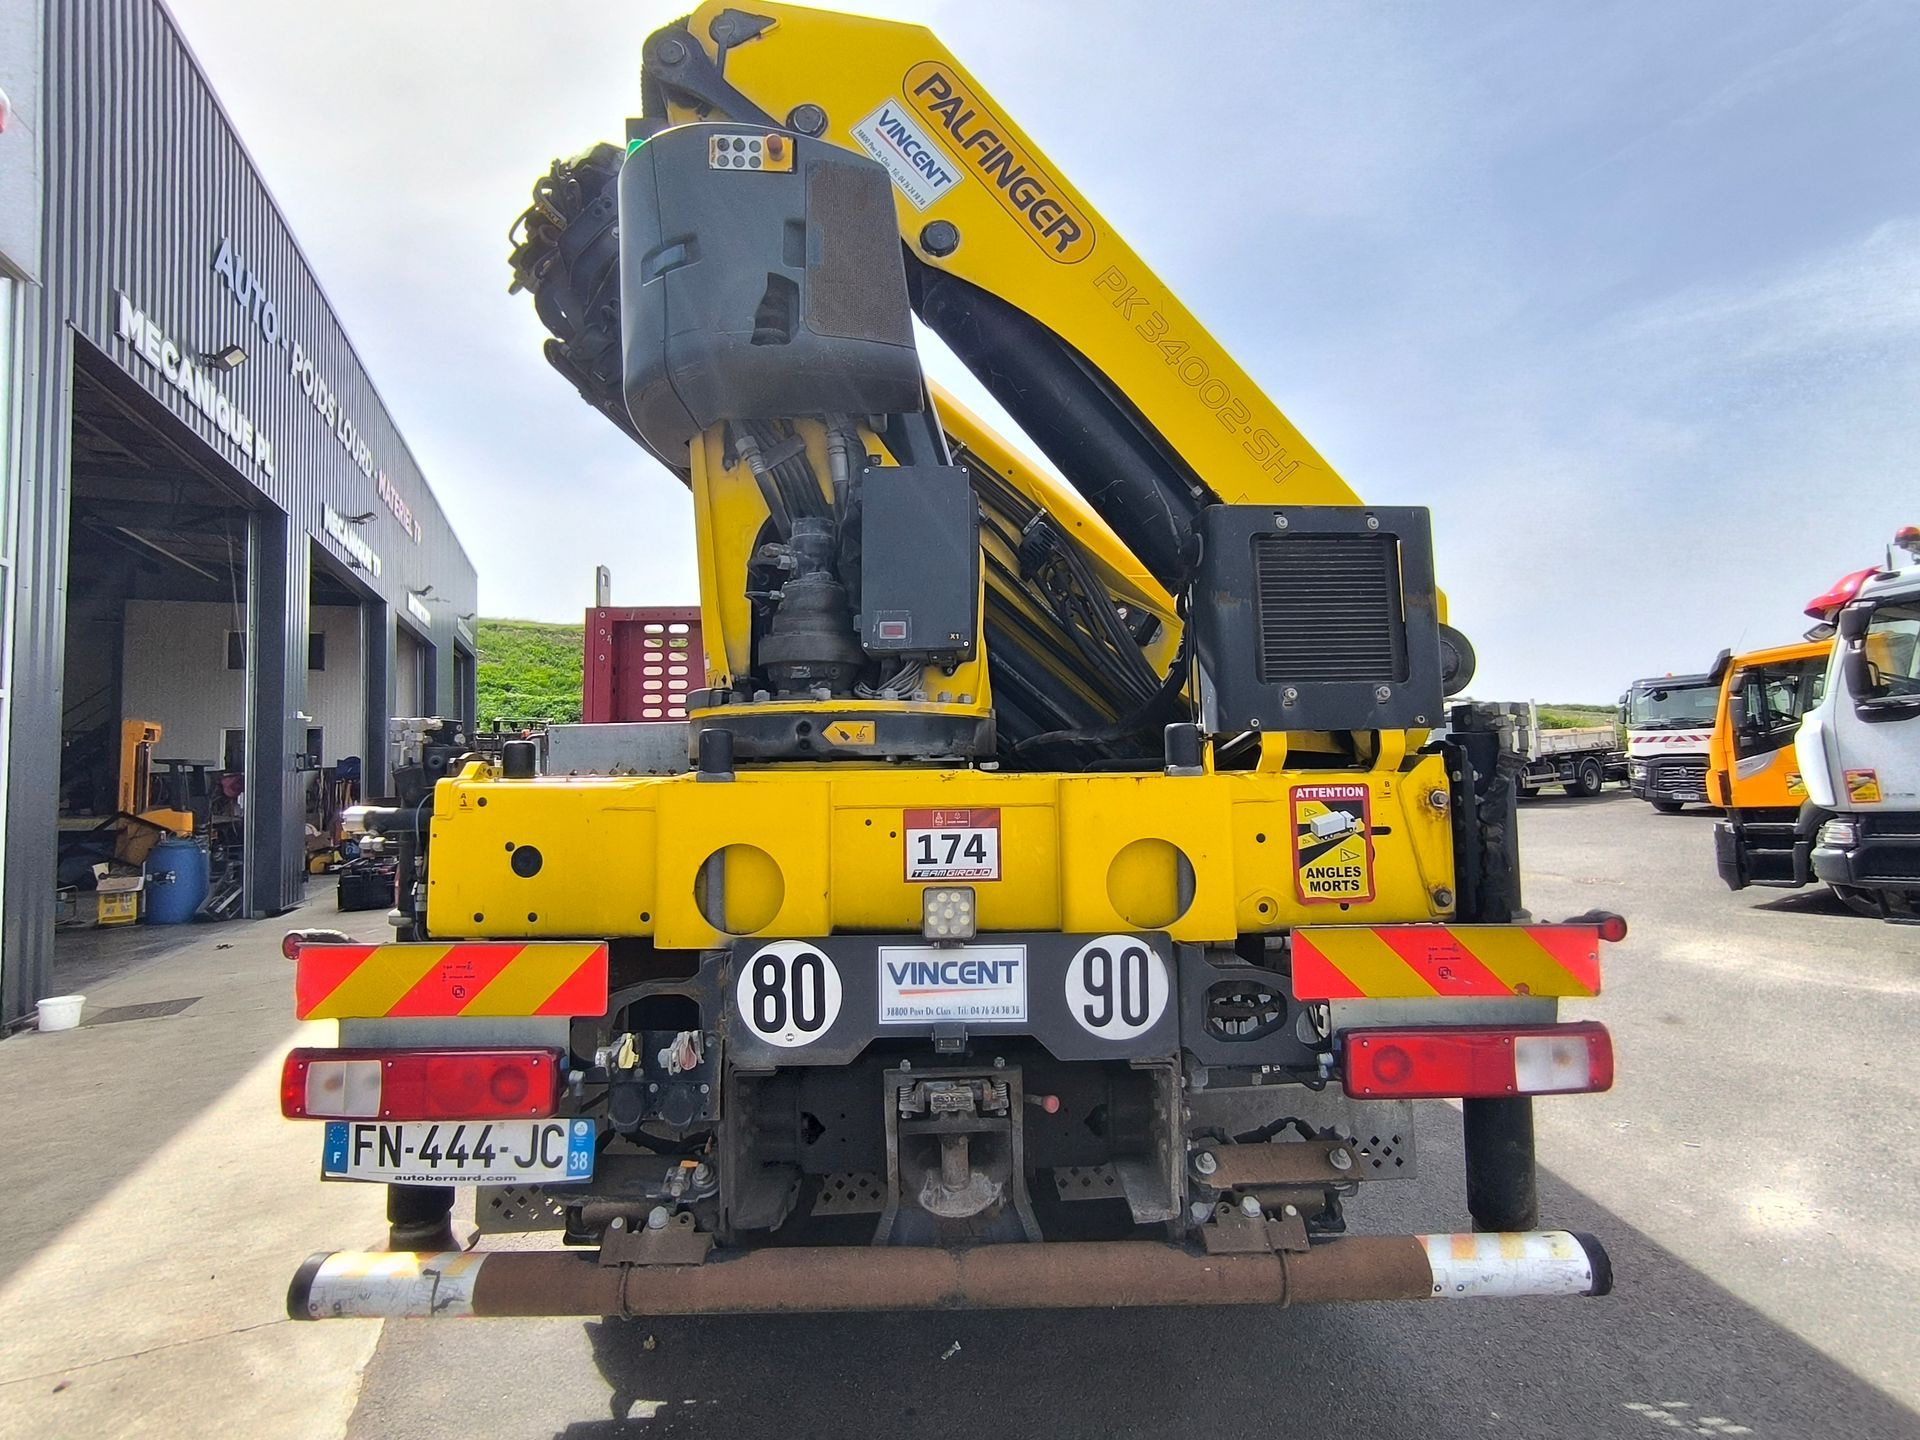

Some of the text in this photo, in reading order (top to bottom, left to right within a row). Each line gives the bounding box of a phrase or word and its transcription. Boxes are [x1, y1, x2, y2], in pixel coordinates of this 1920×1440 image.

[878, 108, 952, 188] VINCENT
[913, 71, 1082, 254] PALFINGER
[1093, 264, 1150, 321] PK
[213, 237, 279, 345] AUTO
[290, 340, 337, 429] POIDS
[336, 406, 374, 478] LOURD
[117, 288, 275, 479] MECANIQUE PL
[1295, 786, 1364, 799] ATTENTION
[917, 833, 987, 865] 174
[1305, 865, 1361, 879] ANGLES
[1309, 879, 1360, 892] MORTS
[886, 960, 1019, 985] VINCENT
[1083, 946, 1149, 1027] 90
[752, 952, 826, 1033] 80
[886, 1006, 908, 1017] 38800
[970, 1006, 981, 1015] 04
[981, 1005, 990, 1015] 76
[991, 1005, 1000, 1014] 24
[1001, 1004, 1010, 1014] 38
[332, 1151, 341, 1164] F
[354, 1124, 565, 1169] FN-444-JC
[570, 1151, 588, 1170] 38
[394, 1173, 517, 1183] autobernard.com
